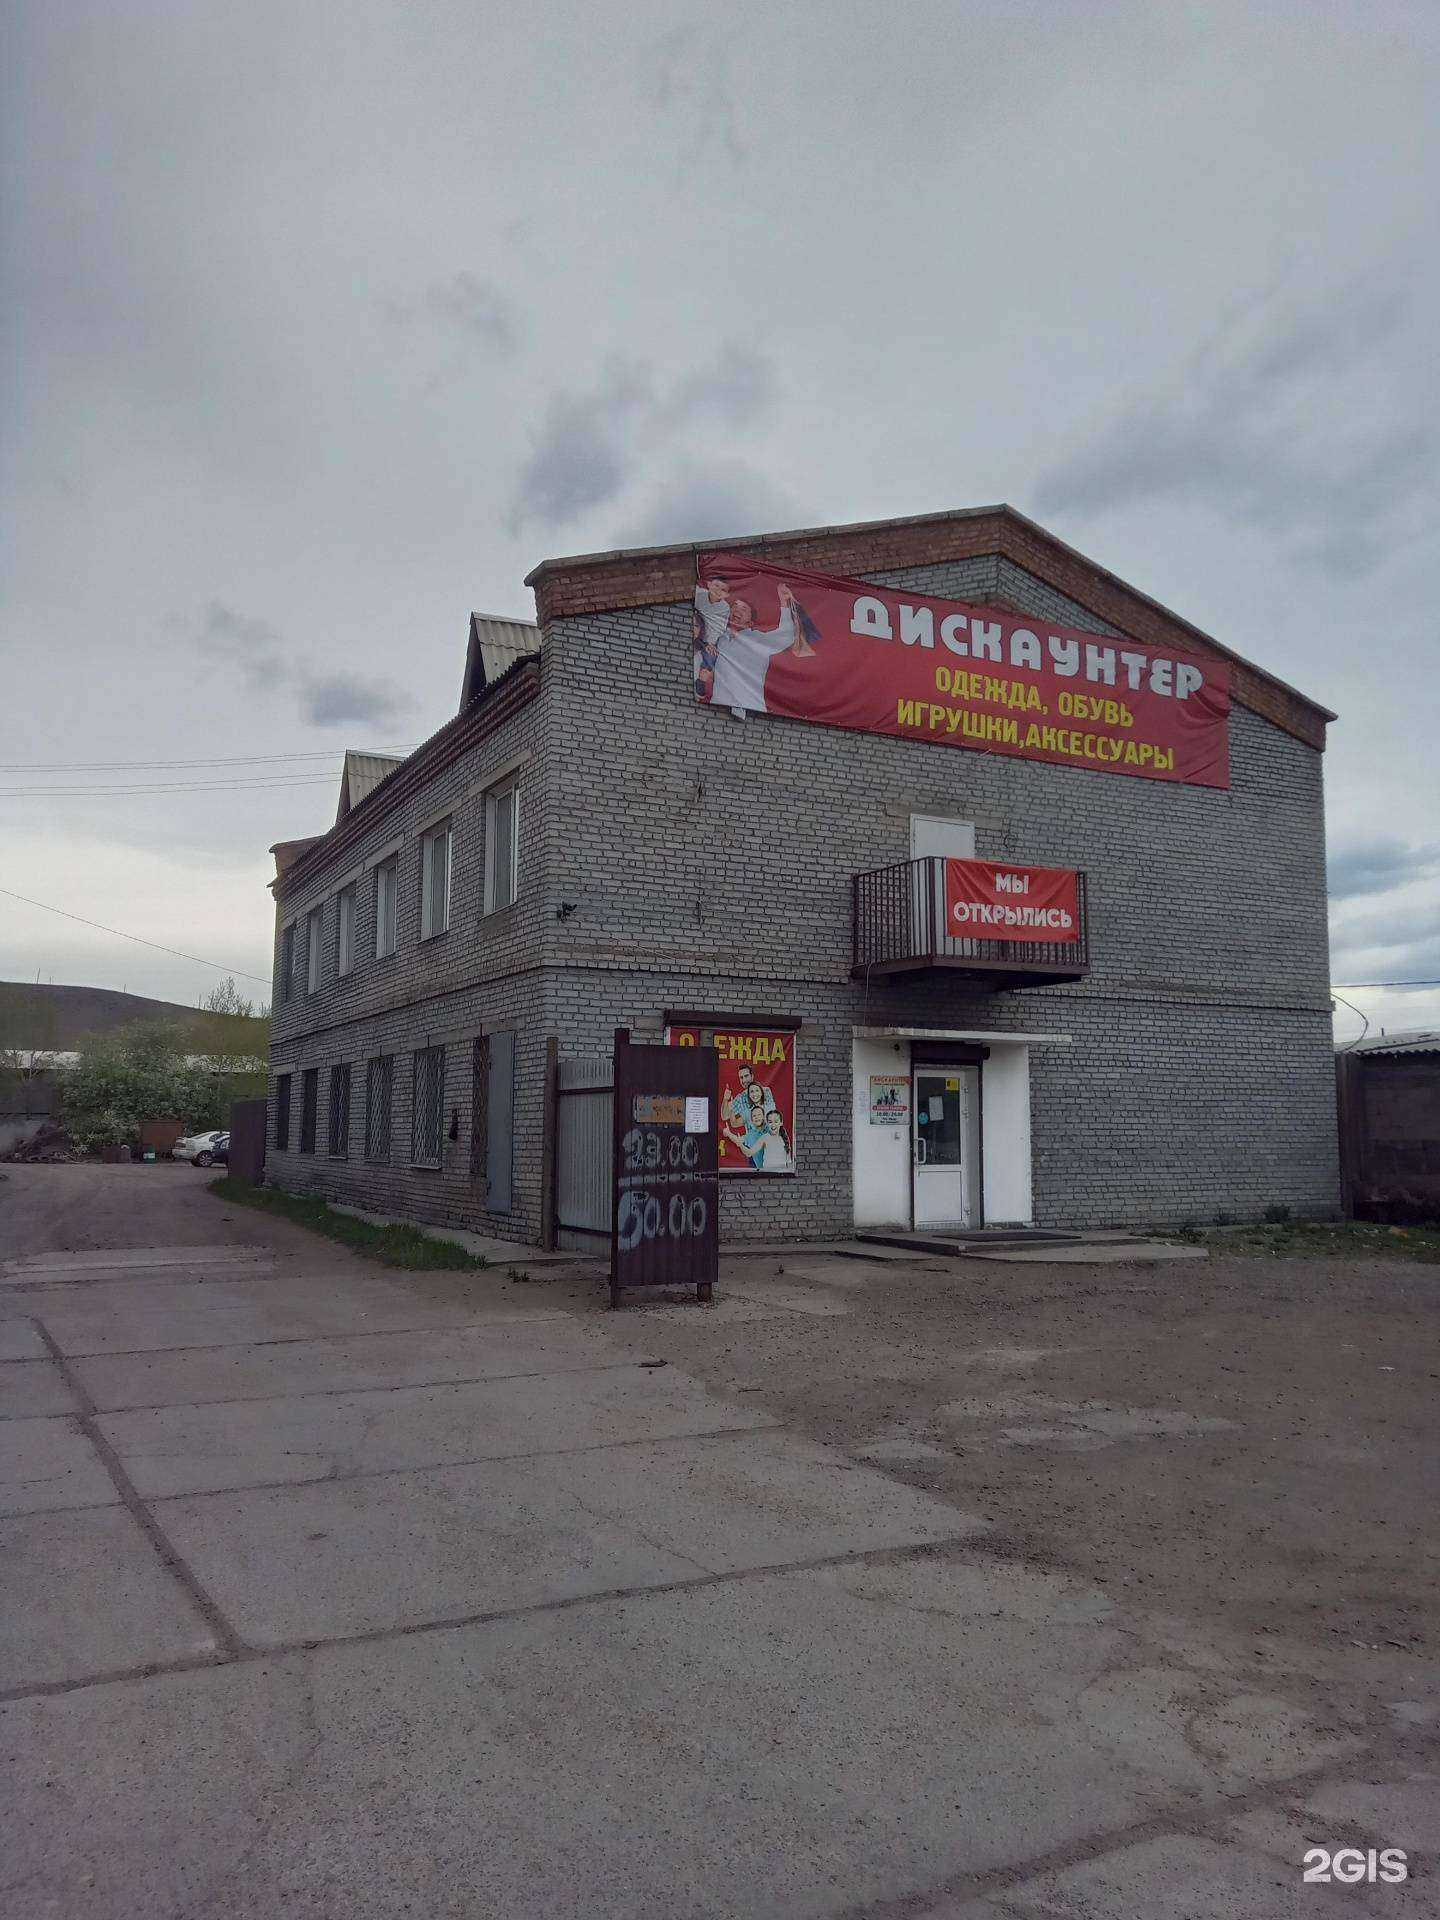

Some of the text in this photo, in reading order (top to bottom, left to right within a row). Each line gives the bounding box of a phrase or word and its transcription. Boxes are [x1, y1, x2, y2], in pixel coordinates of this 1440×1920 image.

[850, 595, 1204, 700] ДИСКАУНТЕР
[935, 666, 1135, 728] ОДЕЖДА, ОБУВЬ
[995, 872, 1030, 894] МЫ
[953, 901, 1073, 928] ОТКРЫЛИСЬ
[679, 1033, 786, 1065] ОЕЖДА
